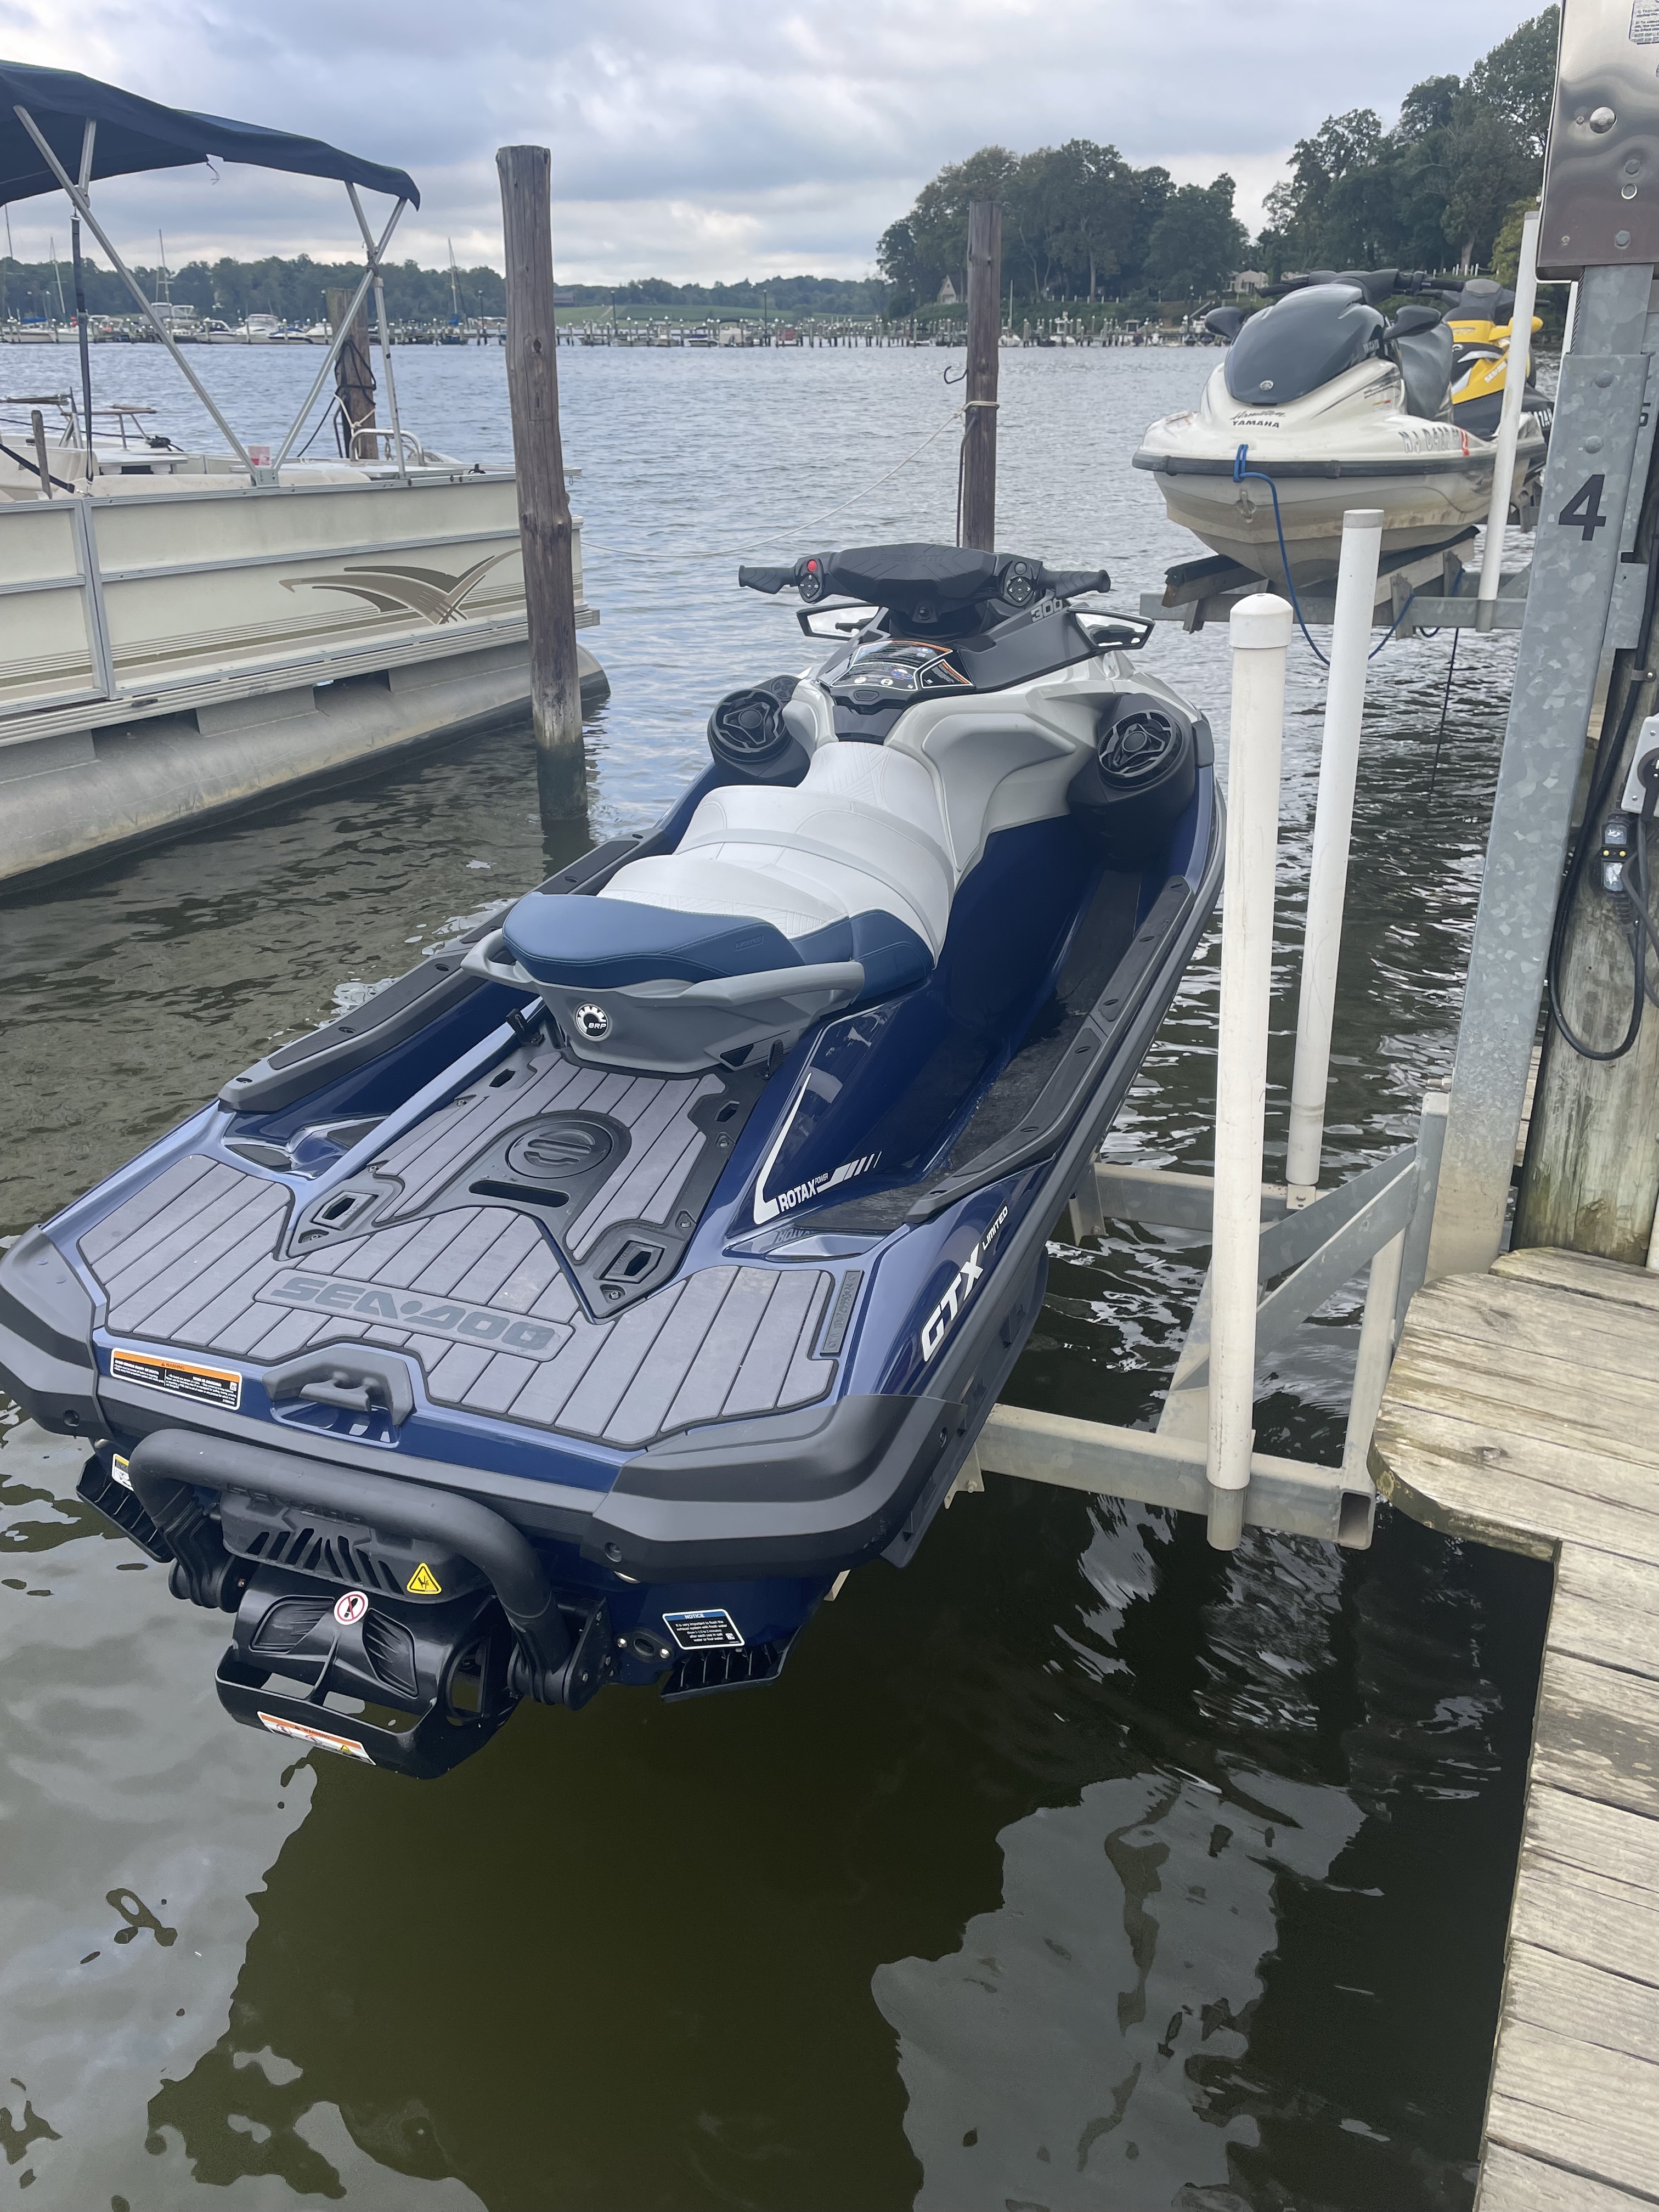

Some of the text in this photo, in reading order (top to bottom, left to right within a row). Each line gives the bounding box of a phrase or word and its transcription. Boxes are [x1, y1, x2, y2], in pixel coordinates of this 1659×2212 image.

[1232, 420, 1279, 428] YAMAHA
[1558, 474, 1607, 541] 4
[1031, 597, 1063, 623] 300
[778, 1172, 829, 1212] ROTAX POWER
[982, 1205, 1008, 1251] LIMITED
[921, 1242, 984, 1362] GTX
